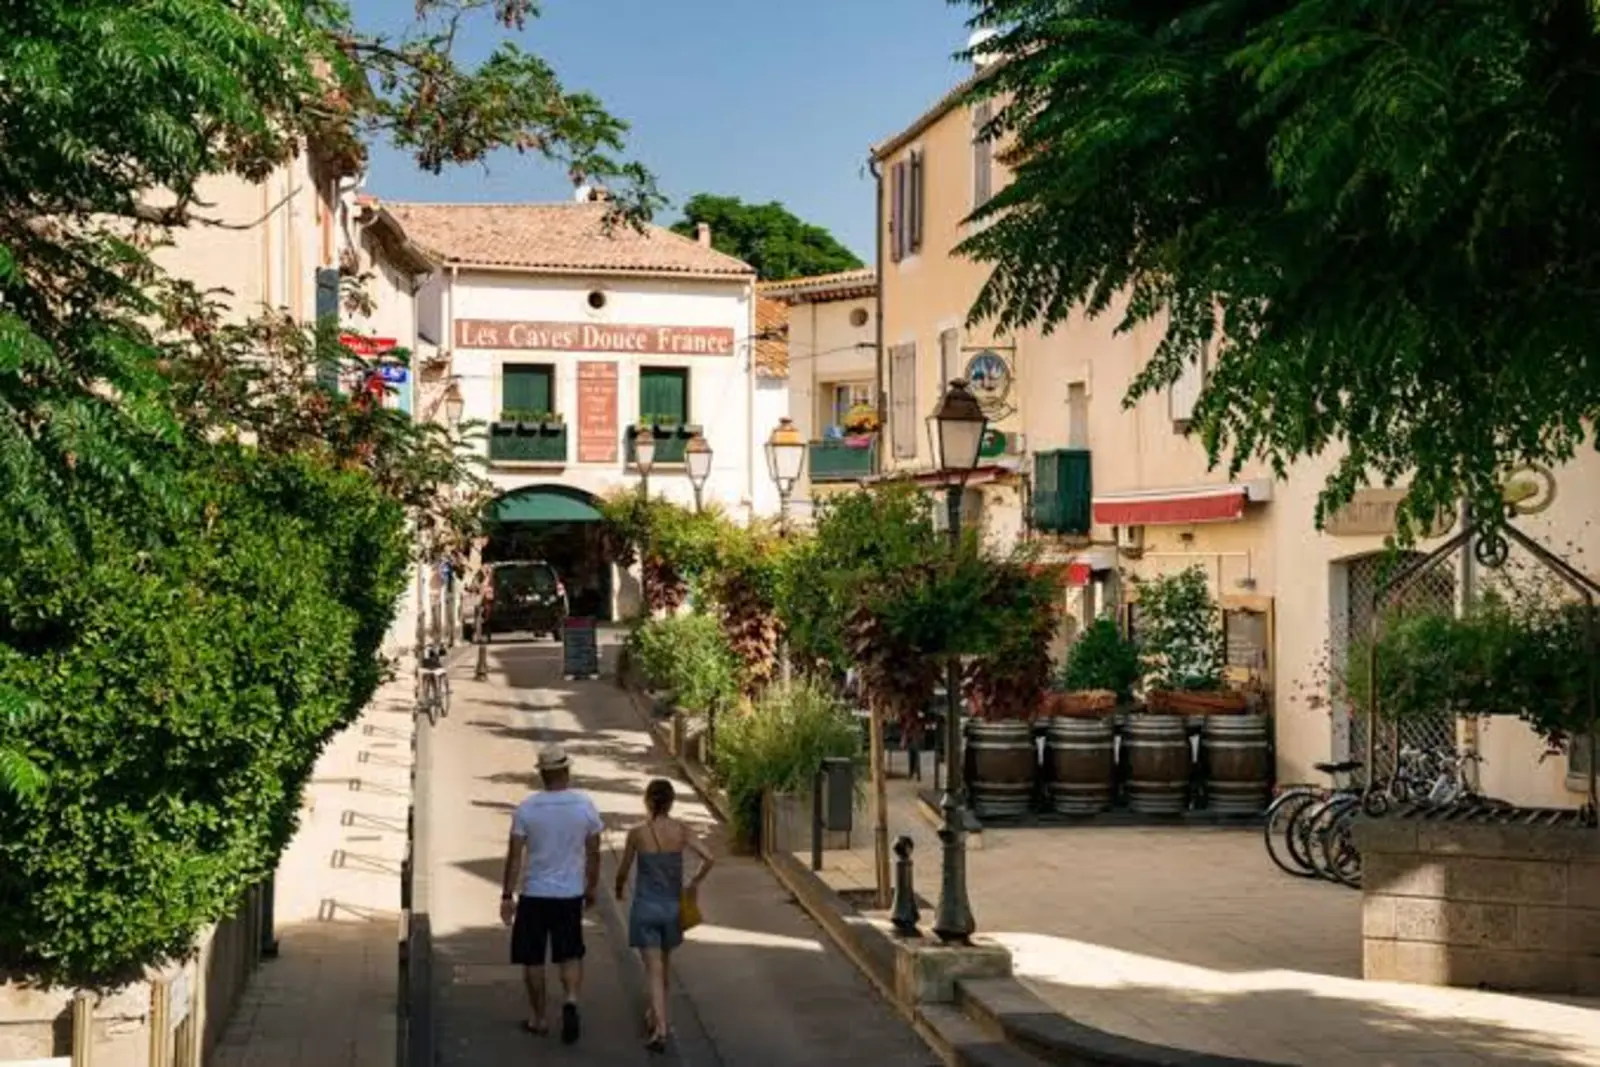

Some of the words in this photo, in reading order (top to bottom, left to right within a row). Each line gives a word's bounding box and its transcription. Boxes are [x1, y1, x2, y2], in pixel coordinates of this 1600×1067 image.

[462, 321, 499, 346] Les
[508, 323, 571, 348] Caves
[583, 325, 648, 350] Douce
[658, 327, 729, 352] France
